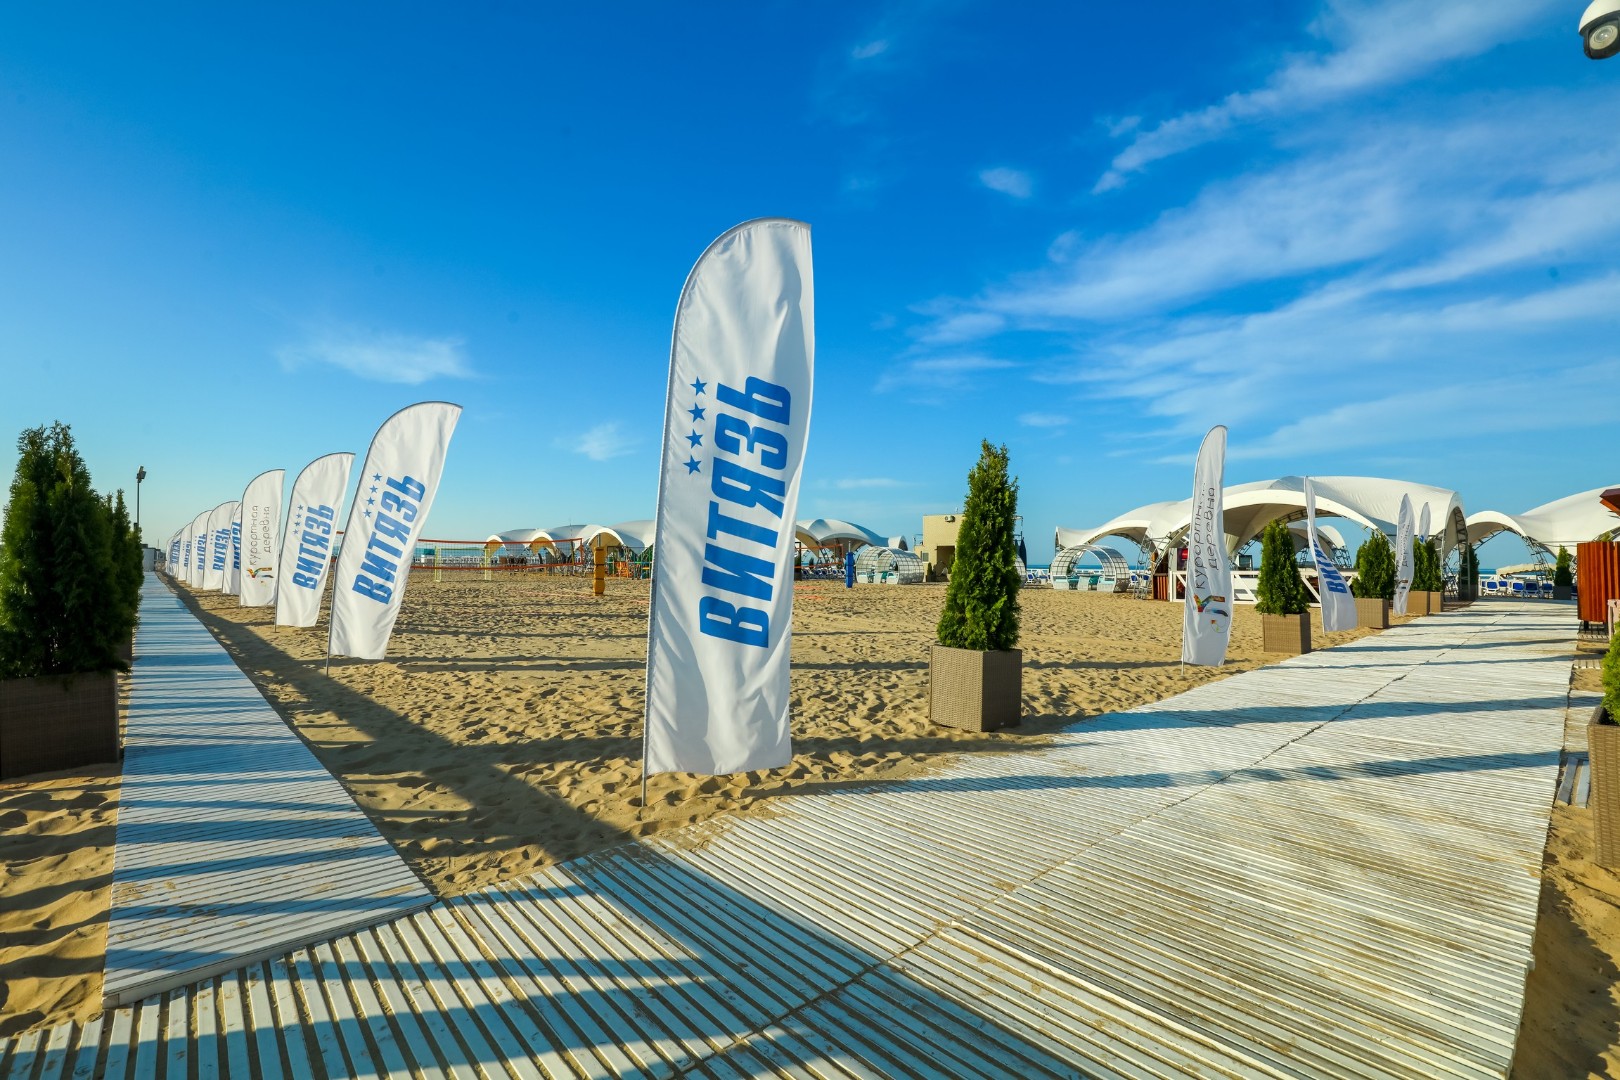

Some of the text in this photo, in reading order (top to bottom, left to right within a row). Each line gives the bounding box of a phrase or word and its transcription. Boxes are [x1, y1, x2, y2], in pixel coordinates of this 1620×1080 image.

[292, 504, 334, 591] ВИТЯЗЬ
[352, 475, 426, 605] ВИТЯЗЬ
[699, 375, 791, 649] ВИТЯЗЬ
[1194, 482, 1208, 590] курортн
